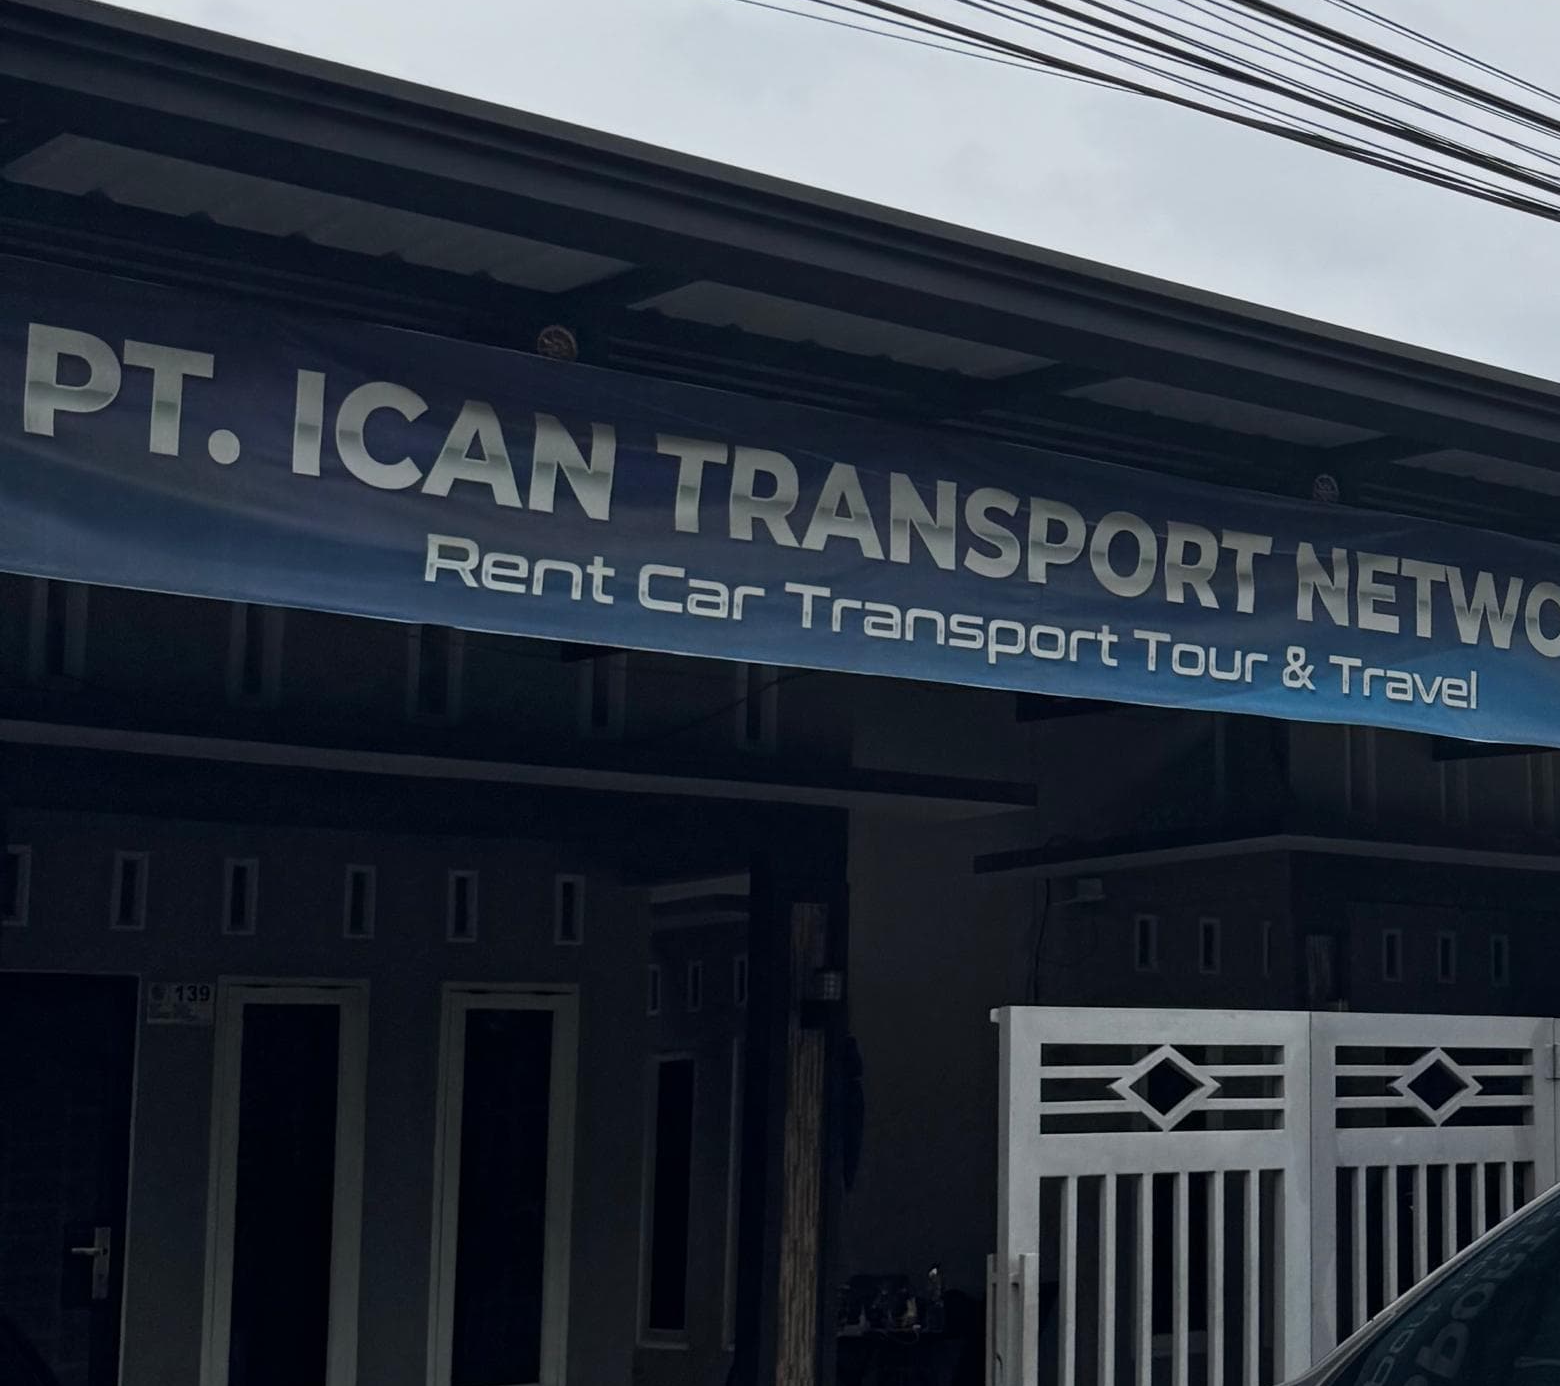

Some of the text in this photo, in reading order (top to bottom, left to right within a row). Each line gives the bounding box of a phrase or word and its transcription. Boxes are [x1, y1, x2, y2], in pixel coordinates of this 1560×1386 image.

[24, 322, 241, 465] PT.
[291, 370, 617, 522] ICAN
[655, 431, 1273, 615] TRANSPORT
[424, 533, 1479, 711] Rent Car Transport Tour & Travel
[175, 984, 211, 1002] 139
